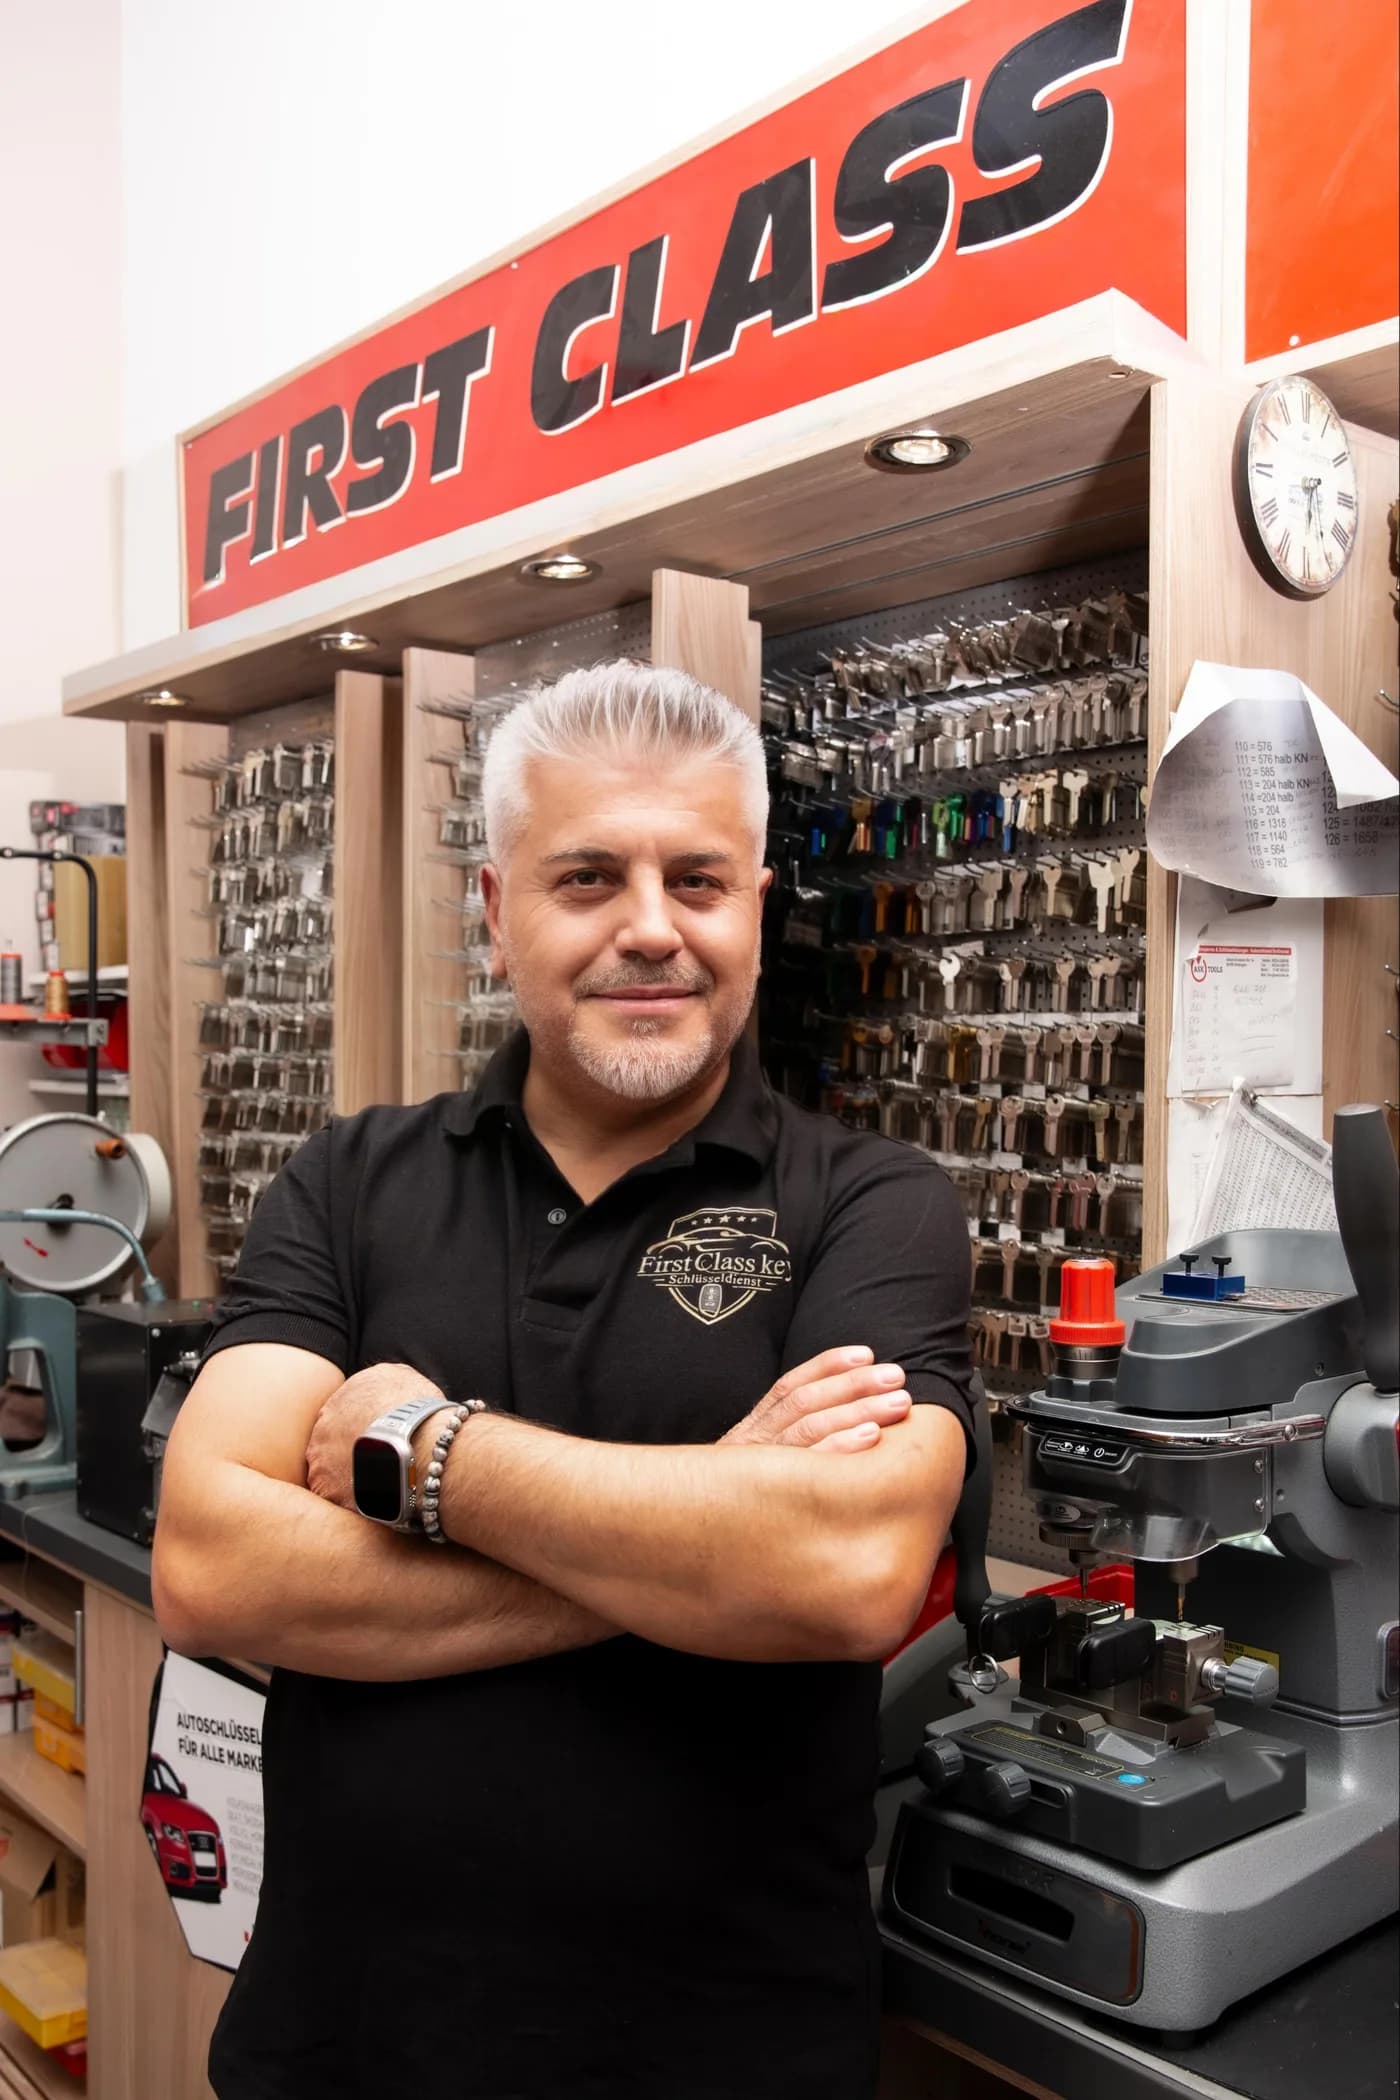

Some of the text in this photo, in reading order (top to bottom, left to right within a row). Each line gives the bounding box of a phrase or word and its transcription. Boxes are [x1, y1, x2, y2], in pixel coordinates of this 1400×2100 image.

[203, 0, 1133, 588] FIRST CLASS
[1235, 741, 1248, 752] 110
[1236, 753, 1248, 764] 111
[1258, 753, 1273, 764] 576
[1274, 753, 1292, 764] halb
[1294, 752, 1309, 764] KN
[1238, 767, 1252, 777] 112
[1240, 779, 1253, 790] 113
[1263, 779, 1277, 790] 204
[1278, 778, 1295, 790] halb
[1296, 778, 1310, 789] KN
[1241, 792, 1256, 802] 114
[1277, 791, 1294, 803] halb
[1243, 805, 1257, 816] 115
[1265, 805, 1280, 816] 204
[1245, 818, 1259, 829] 116
[1323, 816, 1340, 830] 125
[1246, 831, 1260, 842] 117
[1270, 831, 1288, 842] 1140
[1324, 832, 1341, 846] 126
[1247, 844, 1262, 855] 118
[1251, 858, 1265, 869] 119
[637, 1251, 792, 1281] First Class key
[668, 1273, 762, 1287] Schlüsseldienst
[176, 1711, 262, 1746] AUTOSCHLÜSSEL
[178, 1737, 262, 1773] FÜR ALLE MARKE
